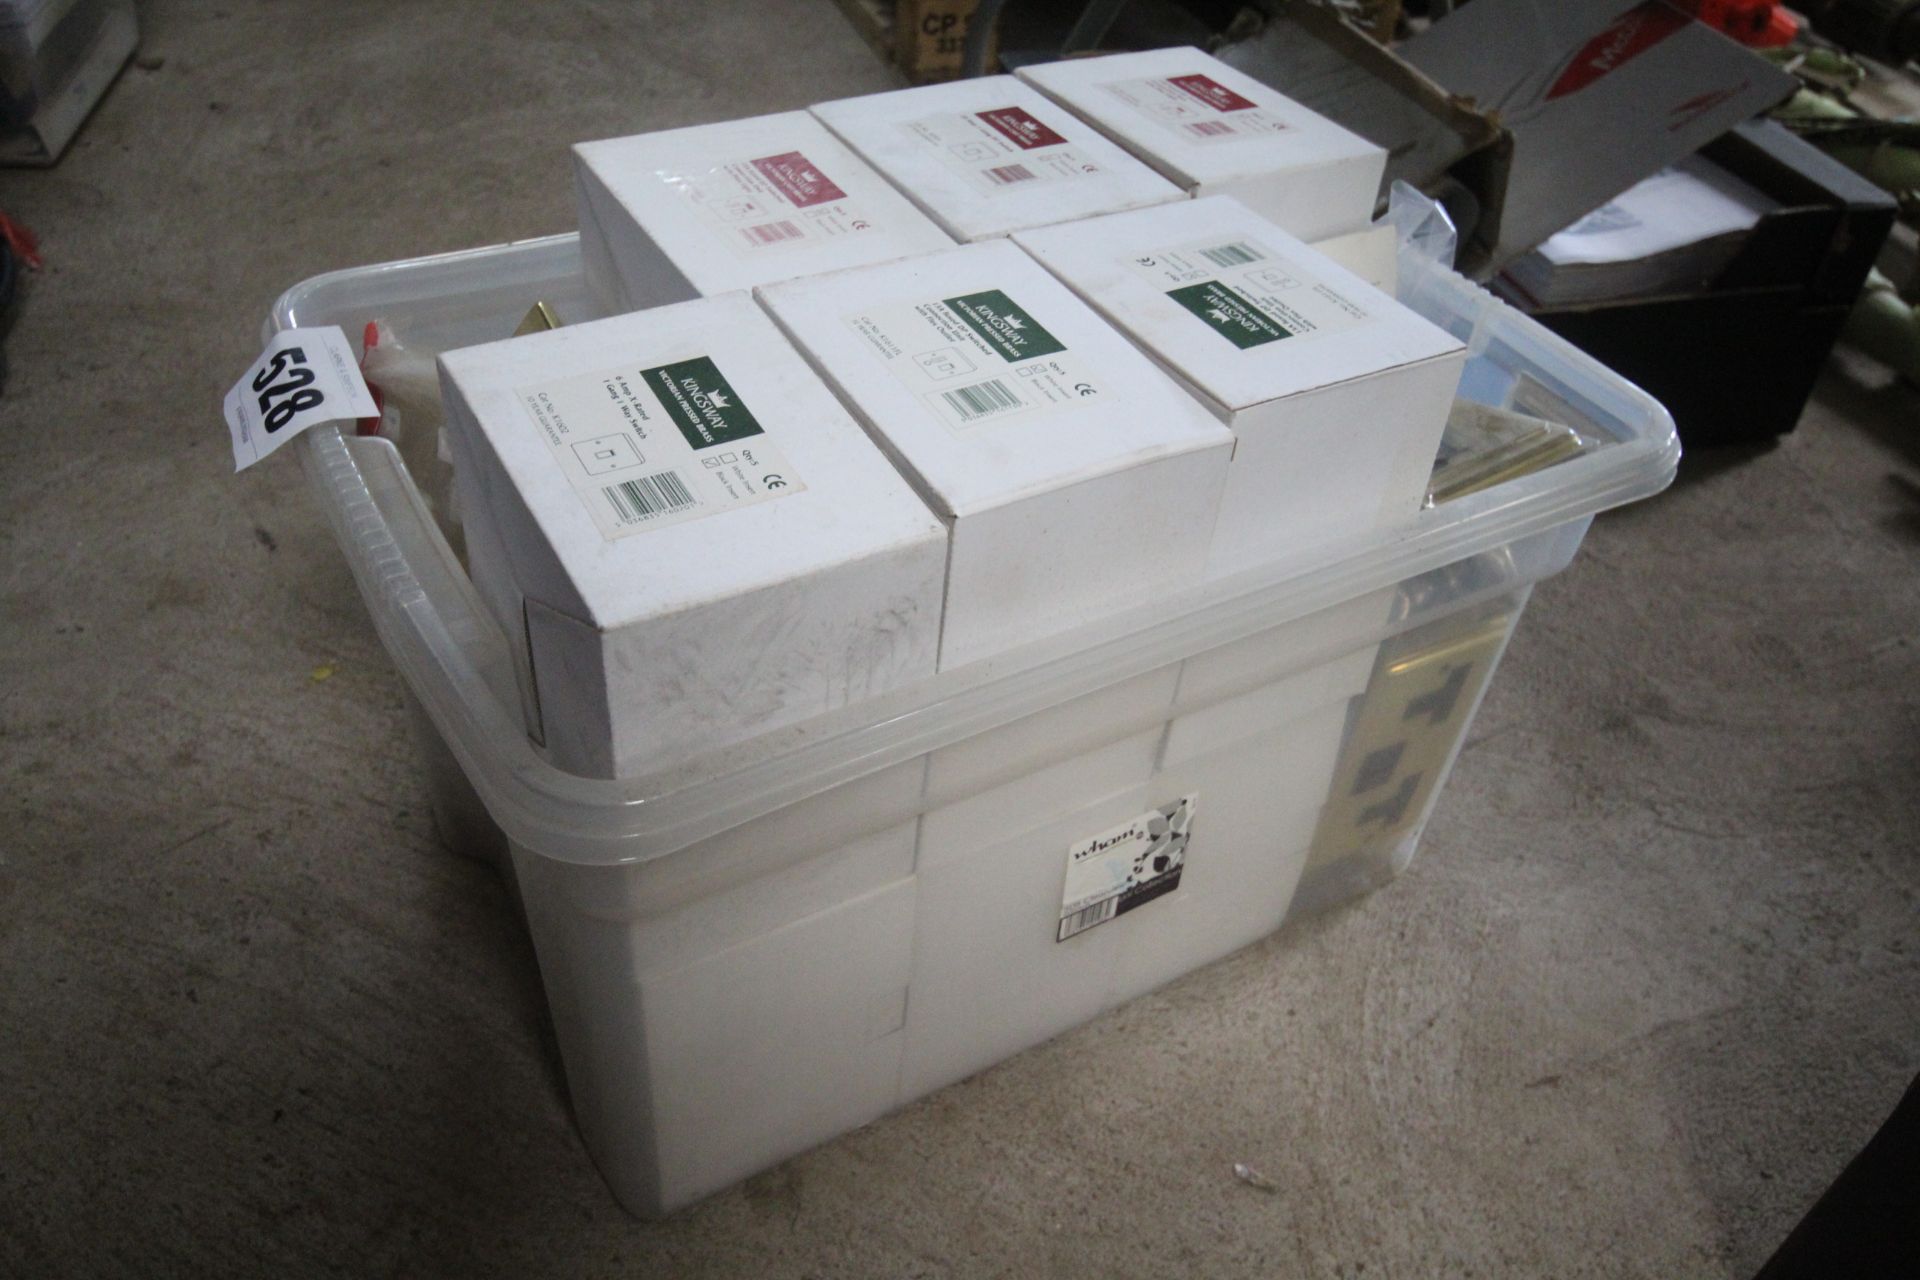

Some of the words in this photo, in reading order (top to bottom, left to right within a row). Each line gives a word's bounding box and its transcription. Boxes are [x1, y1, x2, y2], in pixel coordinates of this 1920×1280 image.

[1135, 256, 1156, 267] CE
[956, 299, 983, 323] VICTORIAN
[983, 322, 1005, 342] PRESSED
[1004, 341, 1022, 358] BRASS
[975, 304, 1027, 347] KINGSWAY
[1201, 292, 1261, 332] KINGSWAY
[252, 346, 325, 434] 528
[619, 381, 632, 396] Amp
[658, 369, 683, 400] VICTORIAN
[680, 399, 699, 424] PRESSED
[697, 423, 713, 443] BRASS
[681, 376, 727, 430] KINGSWAY
[1074, 382, 1097, 397] CE
[606, 383, 619, 400] Gang
[620, 404, 632, 419] Way
[629, 418, 647, 440] Switch
[762, 473, 787, 490] CE
[1073, 828, 1135, 860] wham
